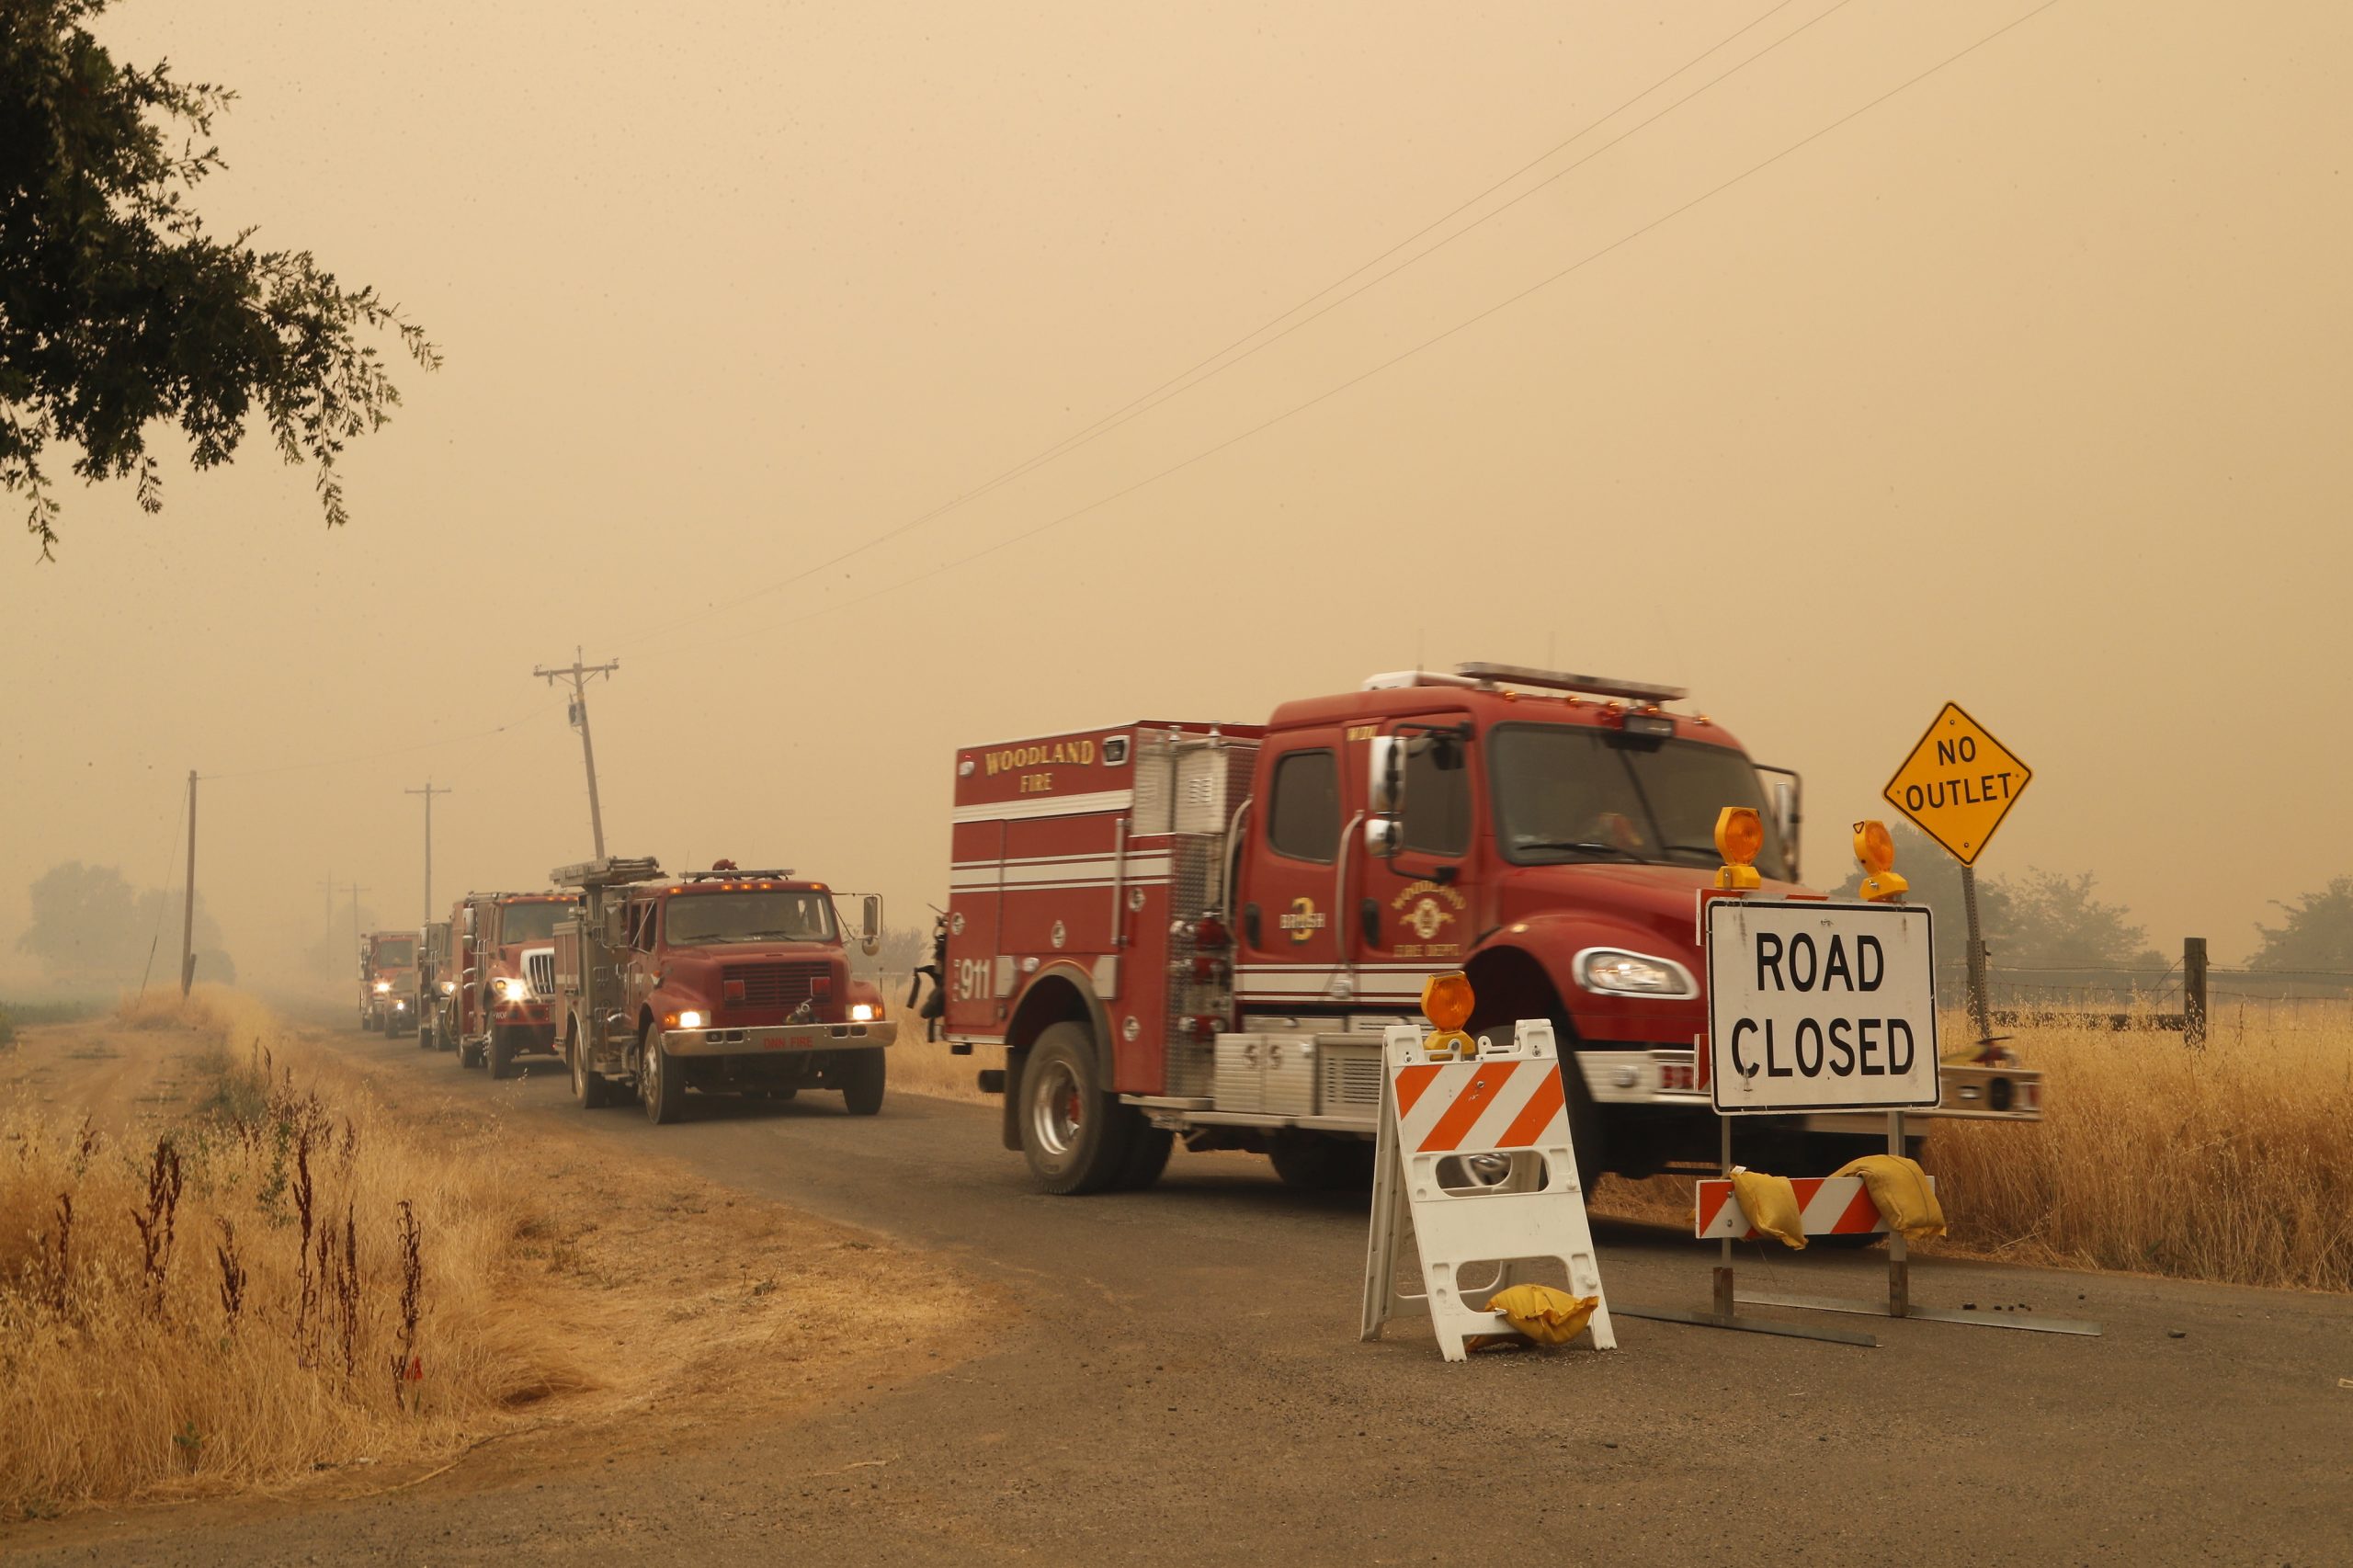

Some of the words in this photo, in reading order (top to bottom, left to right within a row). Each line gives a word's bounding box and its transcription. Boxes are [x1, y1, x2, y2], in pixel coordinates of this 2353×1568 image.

[985, 740, 1096, 776] WOODLAND
[1937, 735, 1976, 766] NO
[1019, 772, 1052, 793] FIRE
[1905, 772, 2011, 812] OUTLET
[1279, 913, 1325, 929] BRUSH
[1291, 896, 1315, 941] 3
[1392, 944, 1424, 957] FIRE
[1756, 932, 1884, 993] ROAD
[961, 958, 991, 1000] 911
[790, 1035, 814, 1048] FIRE
[1731, 1017, 1915, 1078] CLOSED
